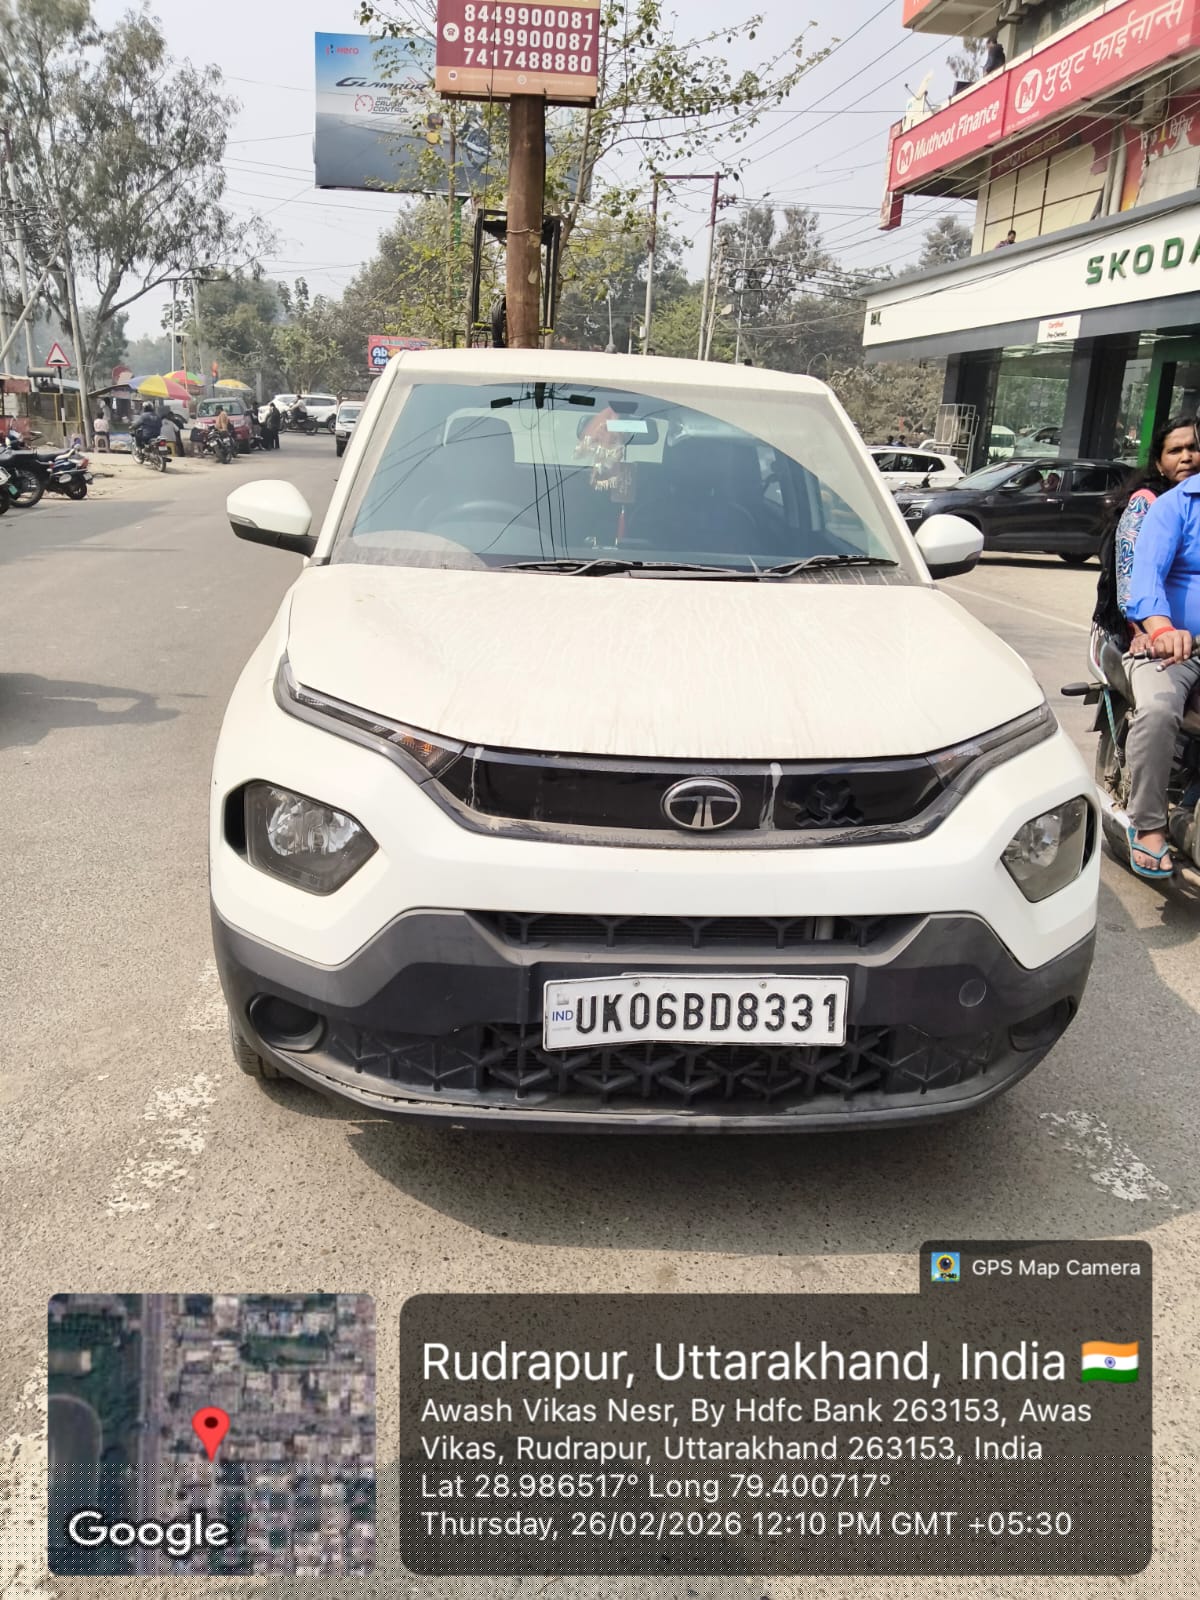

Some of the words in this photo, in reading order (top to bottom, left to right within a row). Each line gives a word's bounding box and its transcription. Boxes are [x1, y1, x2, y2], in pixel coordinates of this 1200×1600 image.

[464, 4, 593, 30] 8449900081
[464, 26, 593, 51] 8449900087
[463, 47, 592, 73] 7417488880
[1042, 44, 1091, 101] मुथूट
[913, 122, 956, 161] Muthoot
[956, 100, 1000, 140] Finance
[552, 1010, 574, 1022] IND
[575, 992, 838, 1034] UK06BD8331
